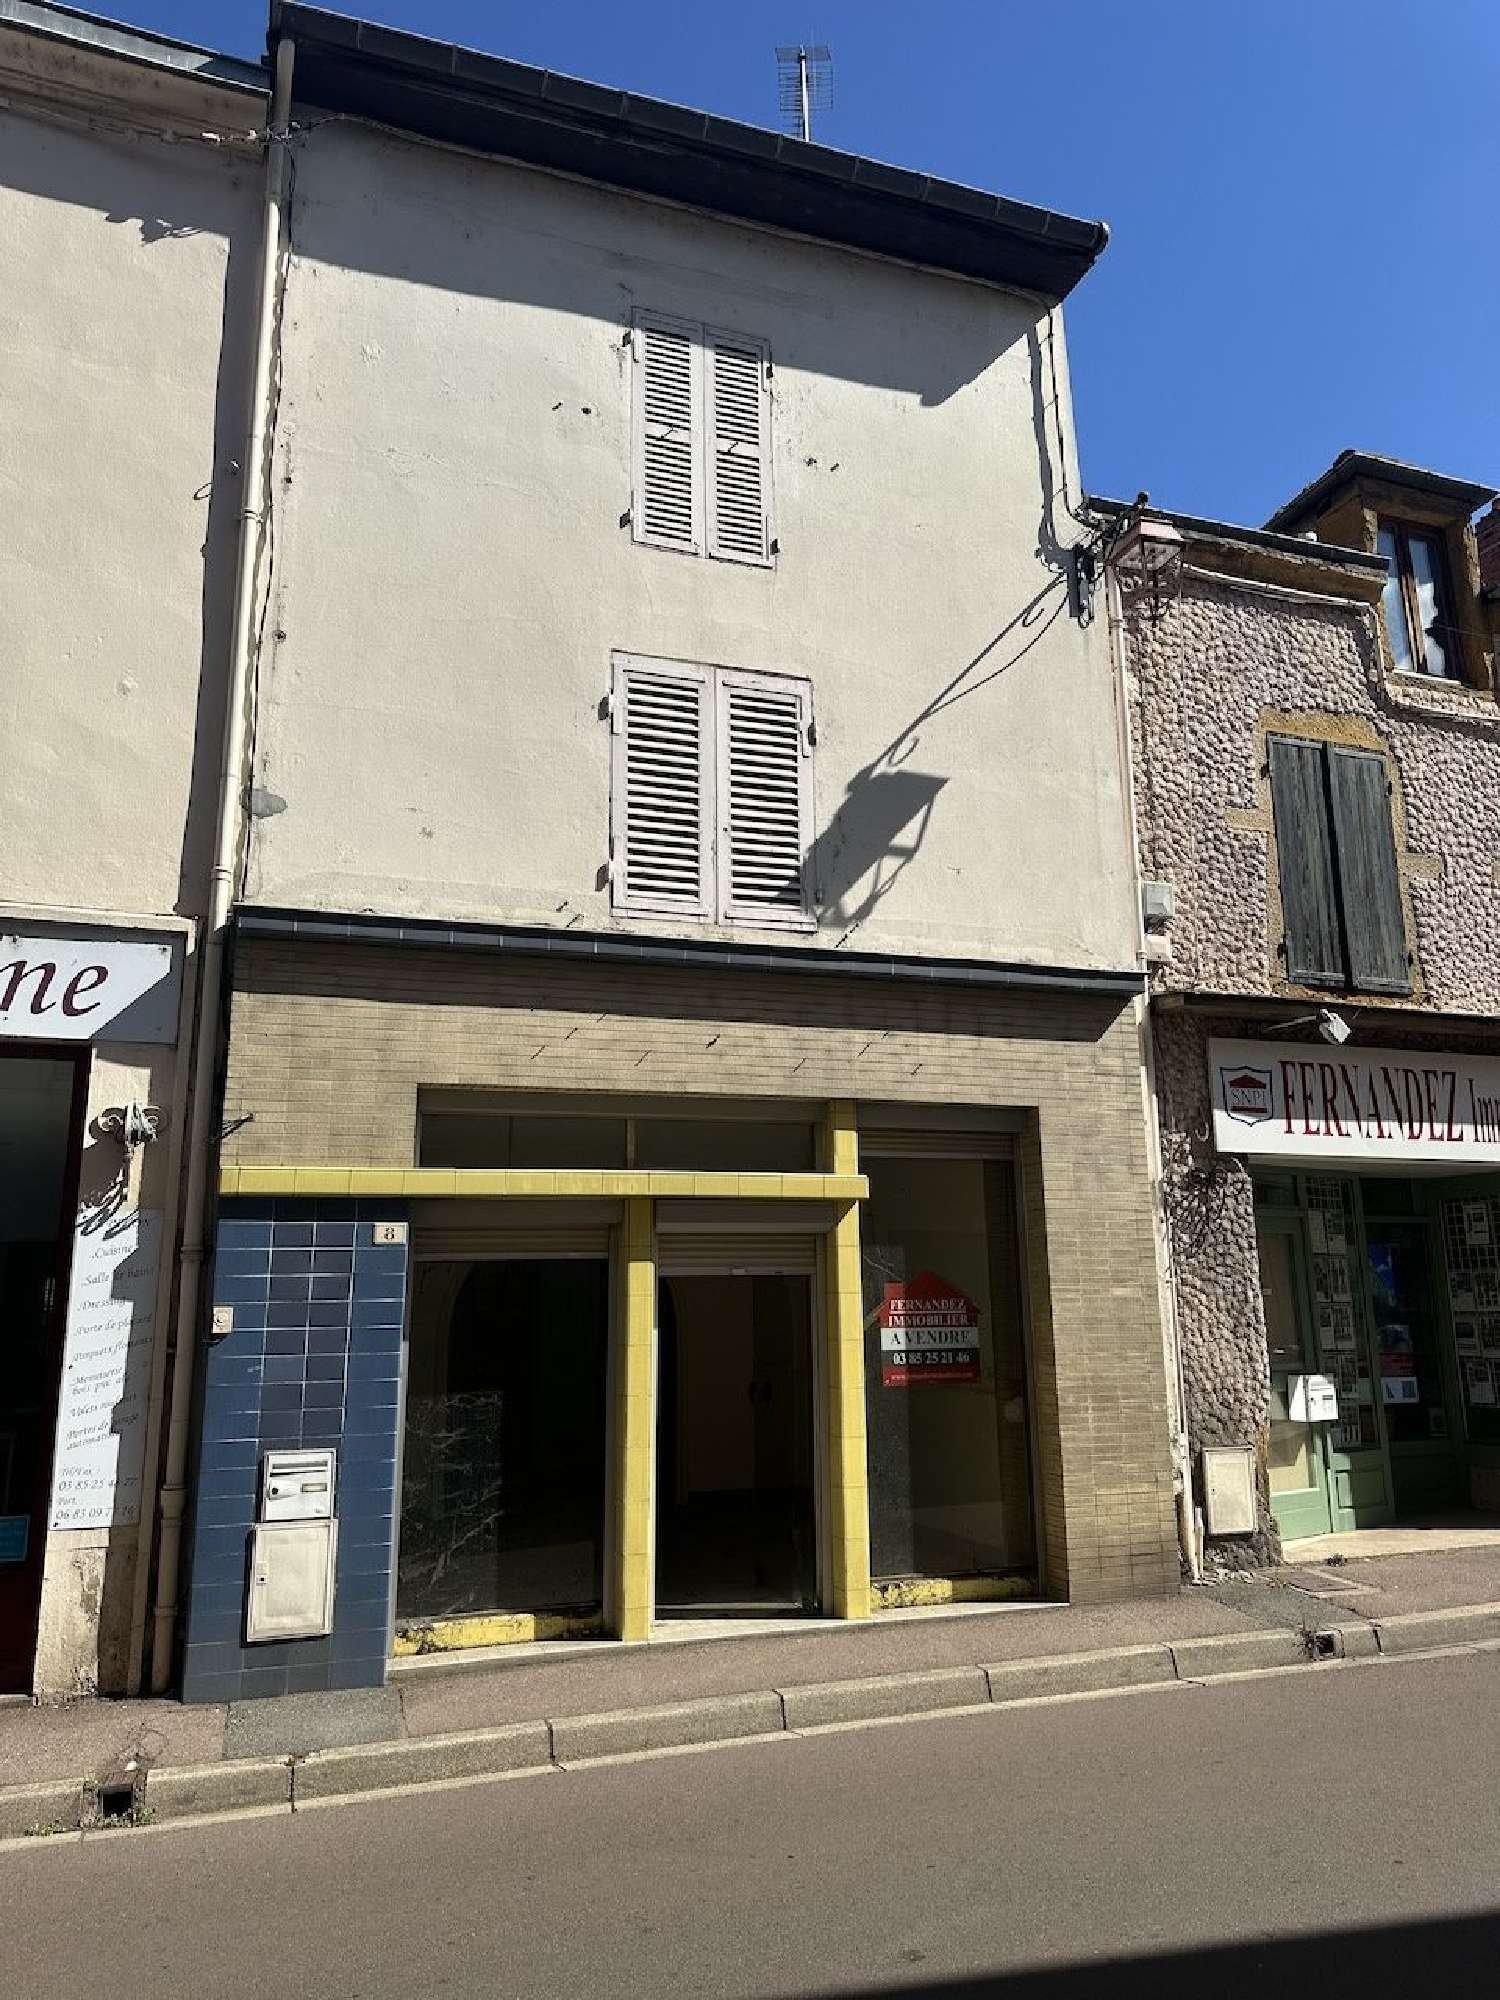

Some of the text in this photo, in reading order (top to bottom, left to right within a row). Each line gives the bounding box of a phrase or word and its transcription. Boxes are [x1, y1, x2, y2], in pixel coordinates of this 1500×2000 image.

[1230, 1088, 1265, 1106] SNPI
[1278, 1060, 1463, 1141] FERNANDEZ
[890, 1299, 967, 1311] FERNANDEZ
[888, 1314, 969, 1328] IMMOBILIER
[905, 1330, 971, 1345] VENDRE
[893, 1353, 906, 1365] 03
